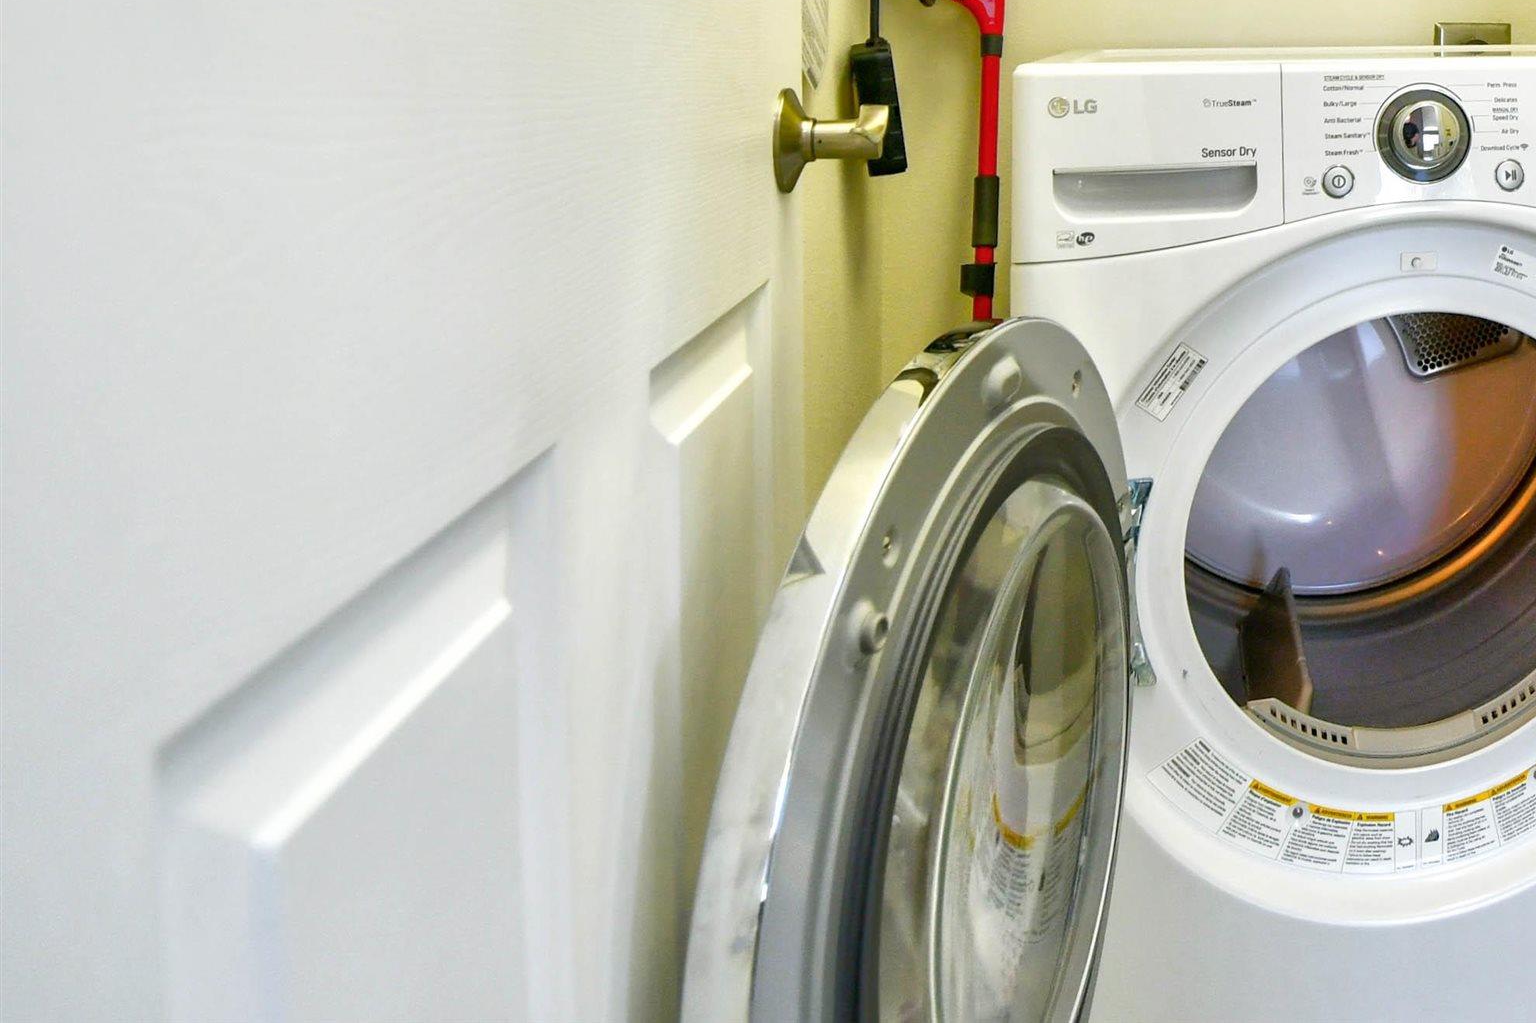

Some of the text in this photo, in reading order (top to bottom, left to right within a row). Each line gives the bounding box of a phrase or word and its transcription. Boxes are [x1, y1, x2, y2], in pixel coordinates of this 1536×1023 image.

[1323, 84, 1364, 92] Cotton/Normal
[1073, 99, 1098, 114] LG
[1323, 100, 1358, 108] Bulky/Large
[1202, 146, 1256, 158] Sensor Dry
